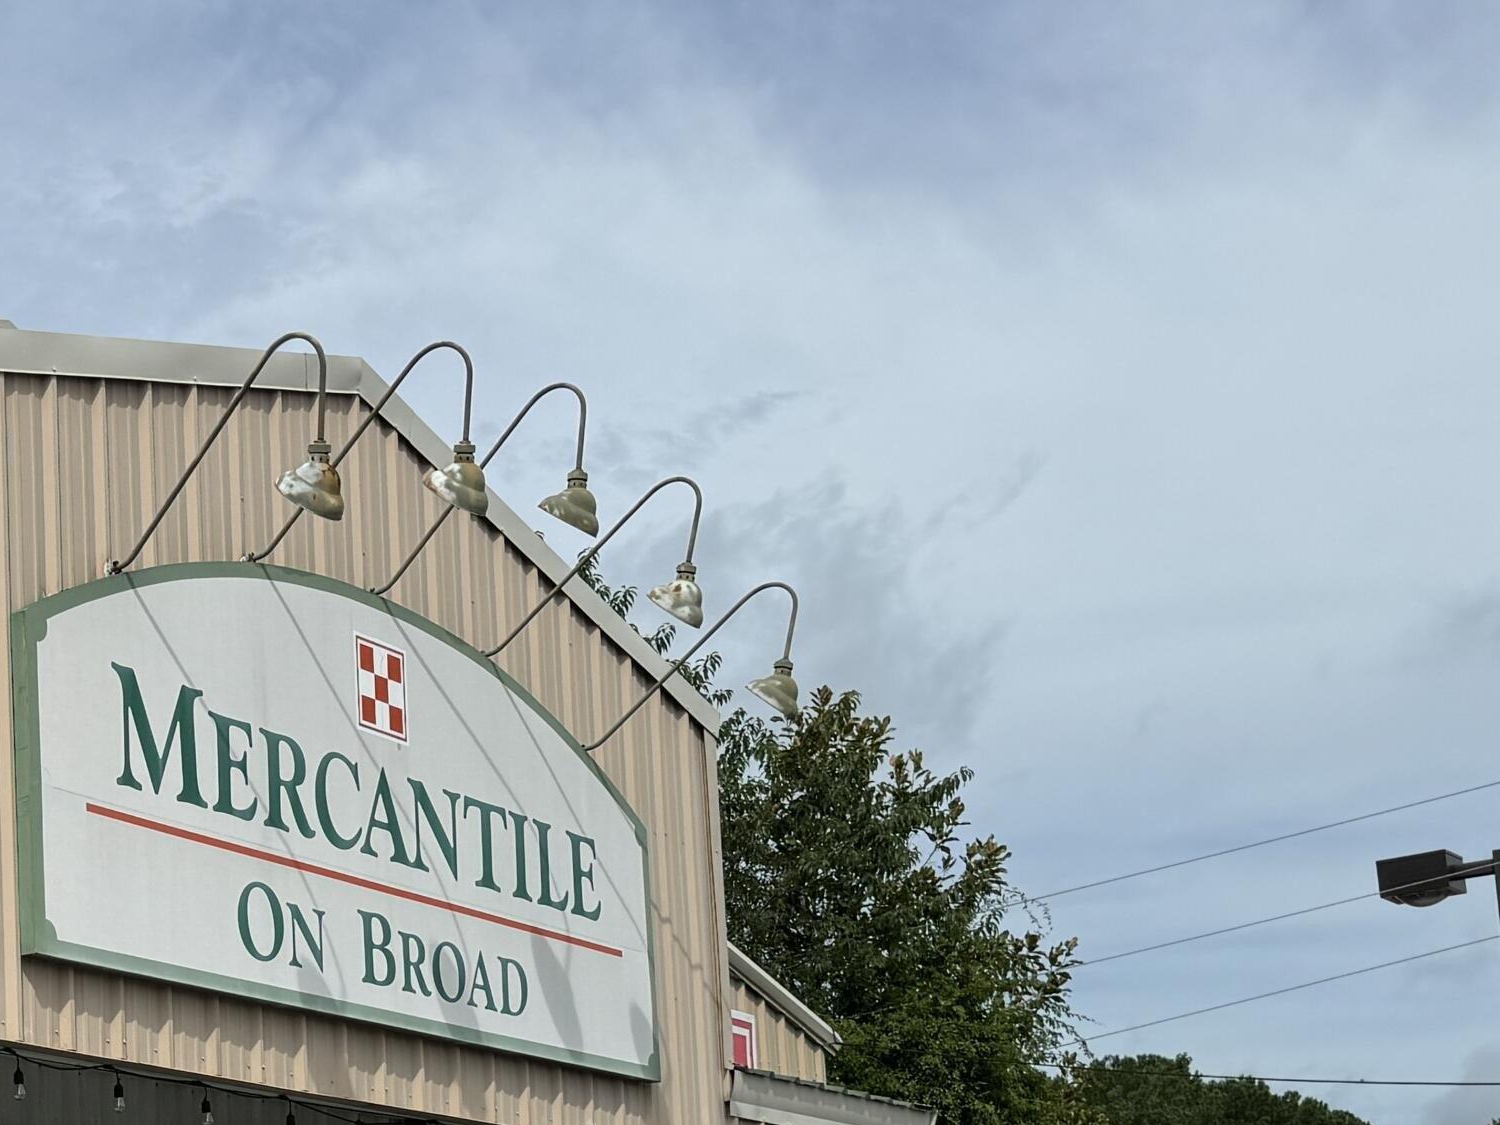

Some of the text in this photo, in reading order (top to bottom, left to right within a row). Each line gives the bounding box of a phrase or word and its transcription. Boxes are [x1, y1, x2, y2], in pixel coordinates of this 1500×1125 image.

[111, 661, 601, 921] MERCANTILE
[237, 881, 529, 1017] ON BROAD
